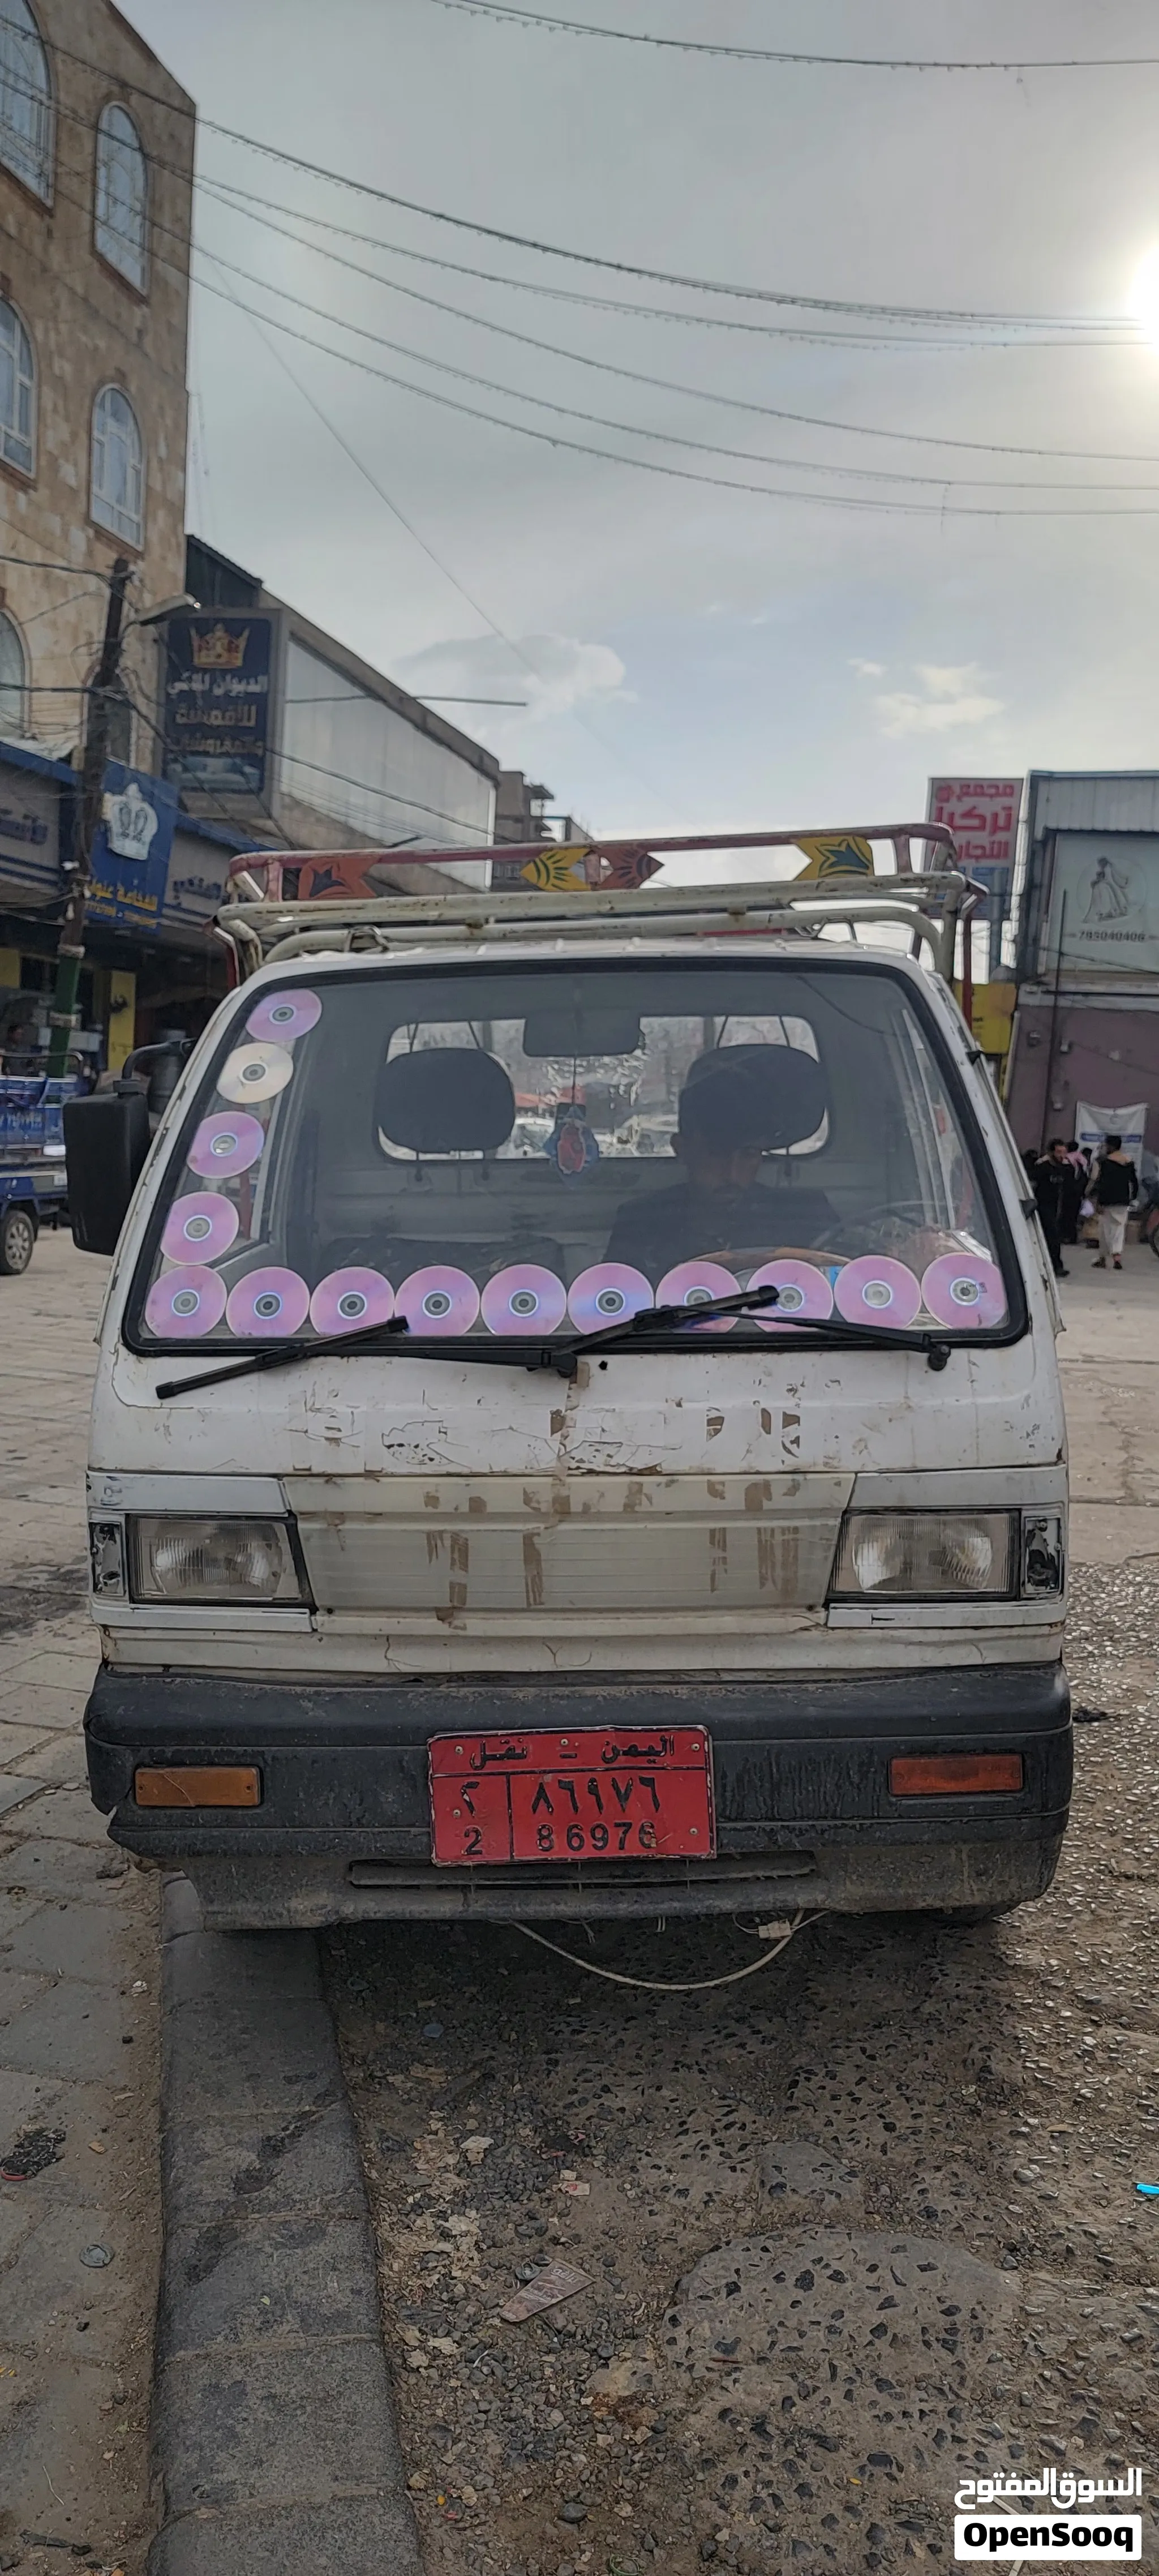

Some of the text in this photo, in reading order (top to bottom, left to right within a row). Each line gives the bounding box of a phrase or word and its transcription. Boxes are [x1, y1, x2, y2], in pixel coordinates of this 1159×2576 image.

[956, 784, 1014, 803] مجمع
[935, 805, 1012, 837] تركيا
[956, 840, 1009, 863] التجار
[470, 1734, 675, 1771] اليمن نقل
[461, 1776, 660, 1816] ٢ ٨٦٩٧٦
[462, 1821, 658, 1855] 2 86976
